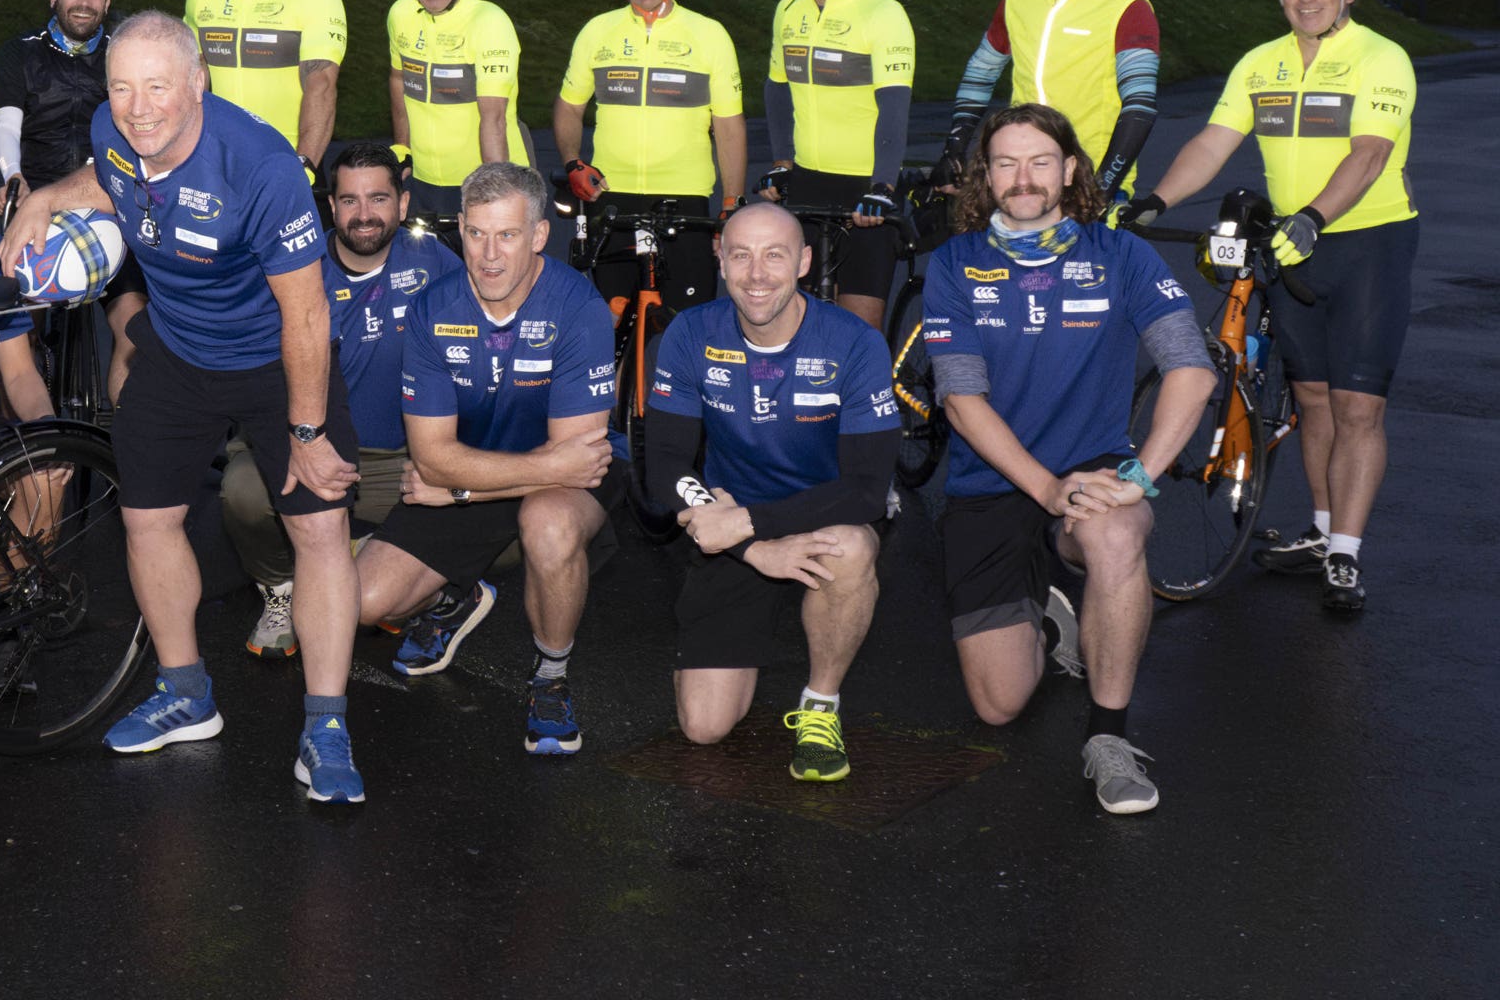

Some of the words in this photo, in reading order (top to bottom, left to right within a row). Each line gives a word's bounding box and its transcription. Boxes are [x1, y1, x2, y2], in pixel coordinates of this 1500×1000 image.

[329, 31, 347, 42] YET
[482, 65, 509, 73] YETI
[885, 62, 911, 72] YETI
[1371, 101, 1402, 116] YETI
[180, 186, 194, 195] KENNY
[193, 189, 211, 200] LOGAN'S
[179, 192, 193, 201] RUGBY
[193, 195, 207, 206] WORLD
[187, 200, 209, 213] CHALLENGE
[279, 211, 312, 236] LOGAN
[281, 227, 317, 253] YETI
[175, 249, 213, 264] Sainsbury's
[1217, 245, 1236, 260] 03
[967, 269, 988, 280] Arnold
[989, 270, 1006, 280] Clark
[436, 326, 458, 335] Arnold
[458, 327, 476, 336] Clark
[923, 330, 952, 340] DAF
[724, 352, 744, 362] Clark
[513, 377, 551, 388] Sainsbury's
[588, 384, 615, 396] YET
[718, 403, 736, 413] BULL
[795, 412, 837, 423] Sainsbury's
